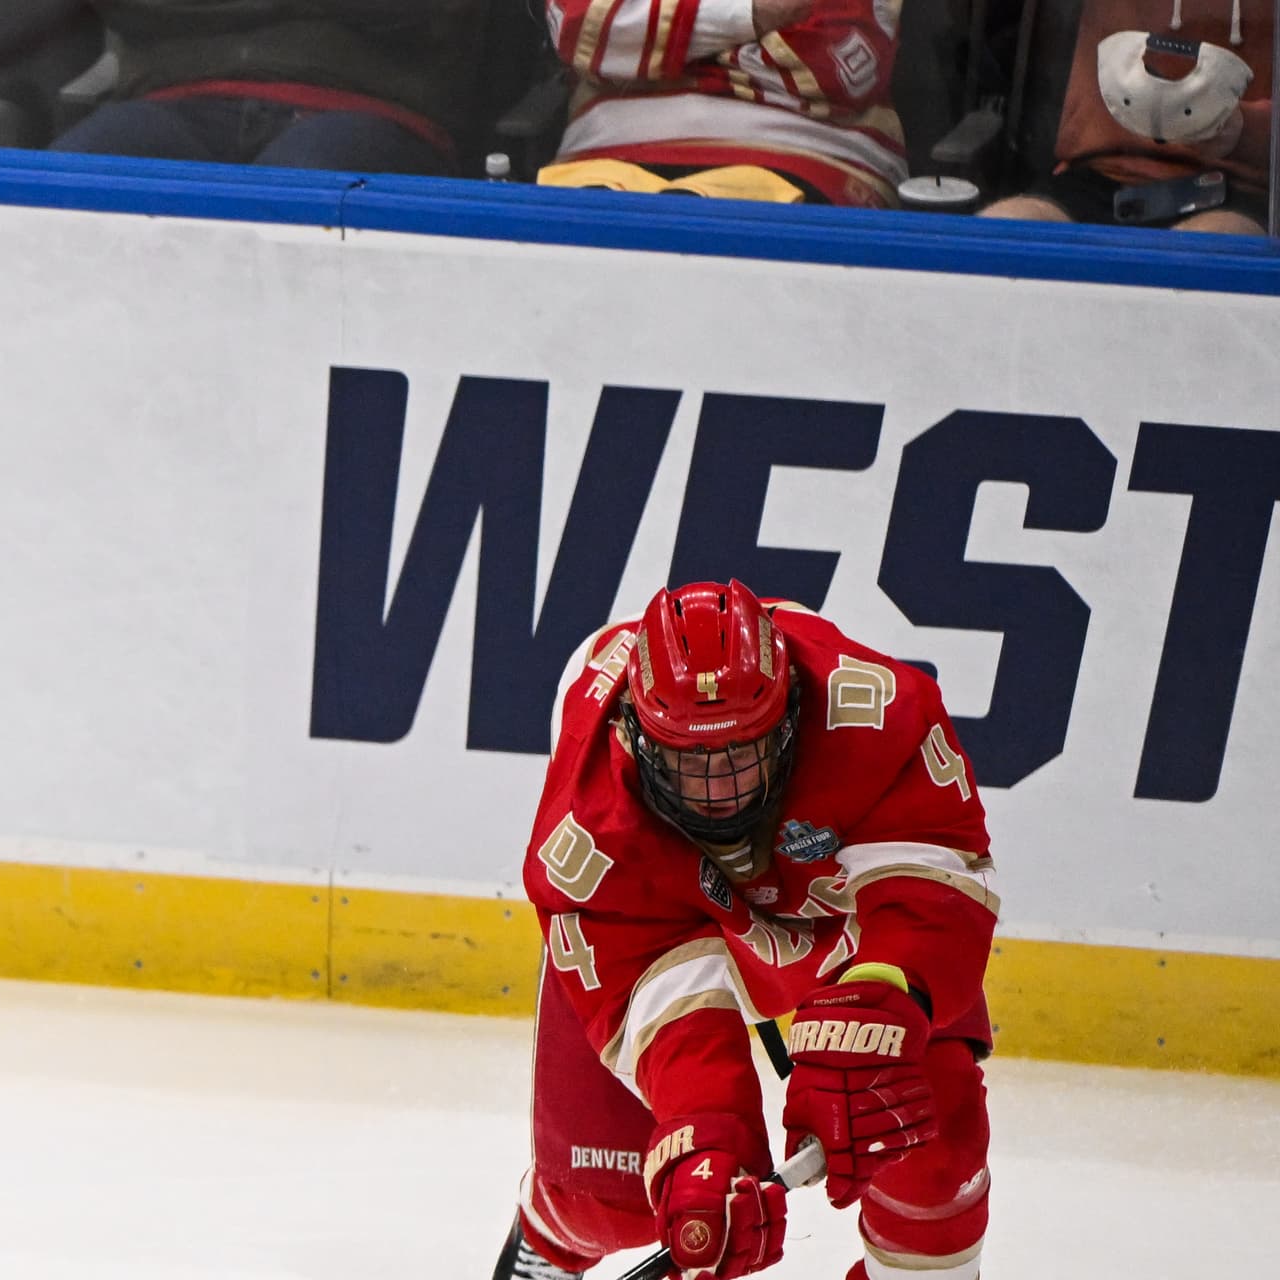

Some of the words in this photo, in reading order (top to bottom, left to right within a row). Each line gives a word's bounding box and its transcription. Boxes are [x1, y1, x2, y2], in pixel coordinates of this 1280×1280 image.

[309, 364, 1280, 802] WEST
[696, 671, 718, 701] 4
[688, 719, 737, 732] WARRIOR
[919, 722, 972, 802] 4
[549, 912, 602, 992] 4
[570, 1144, 641, 1175] DENVER
[690, 1157, 714, 1181] 4
